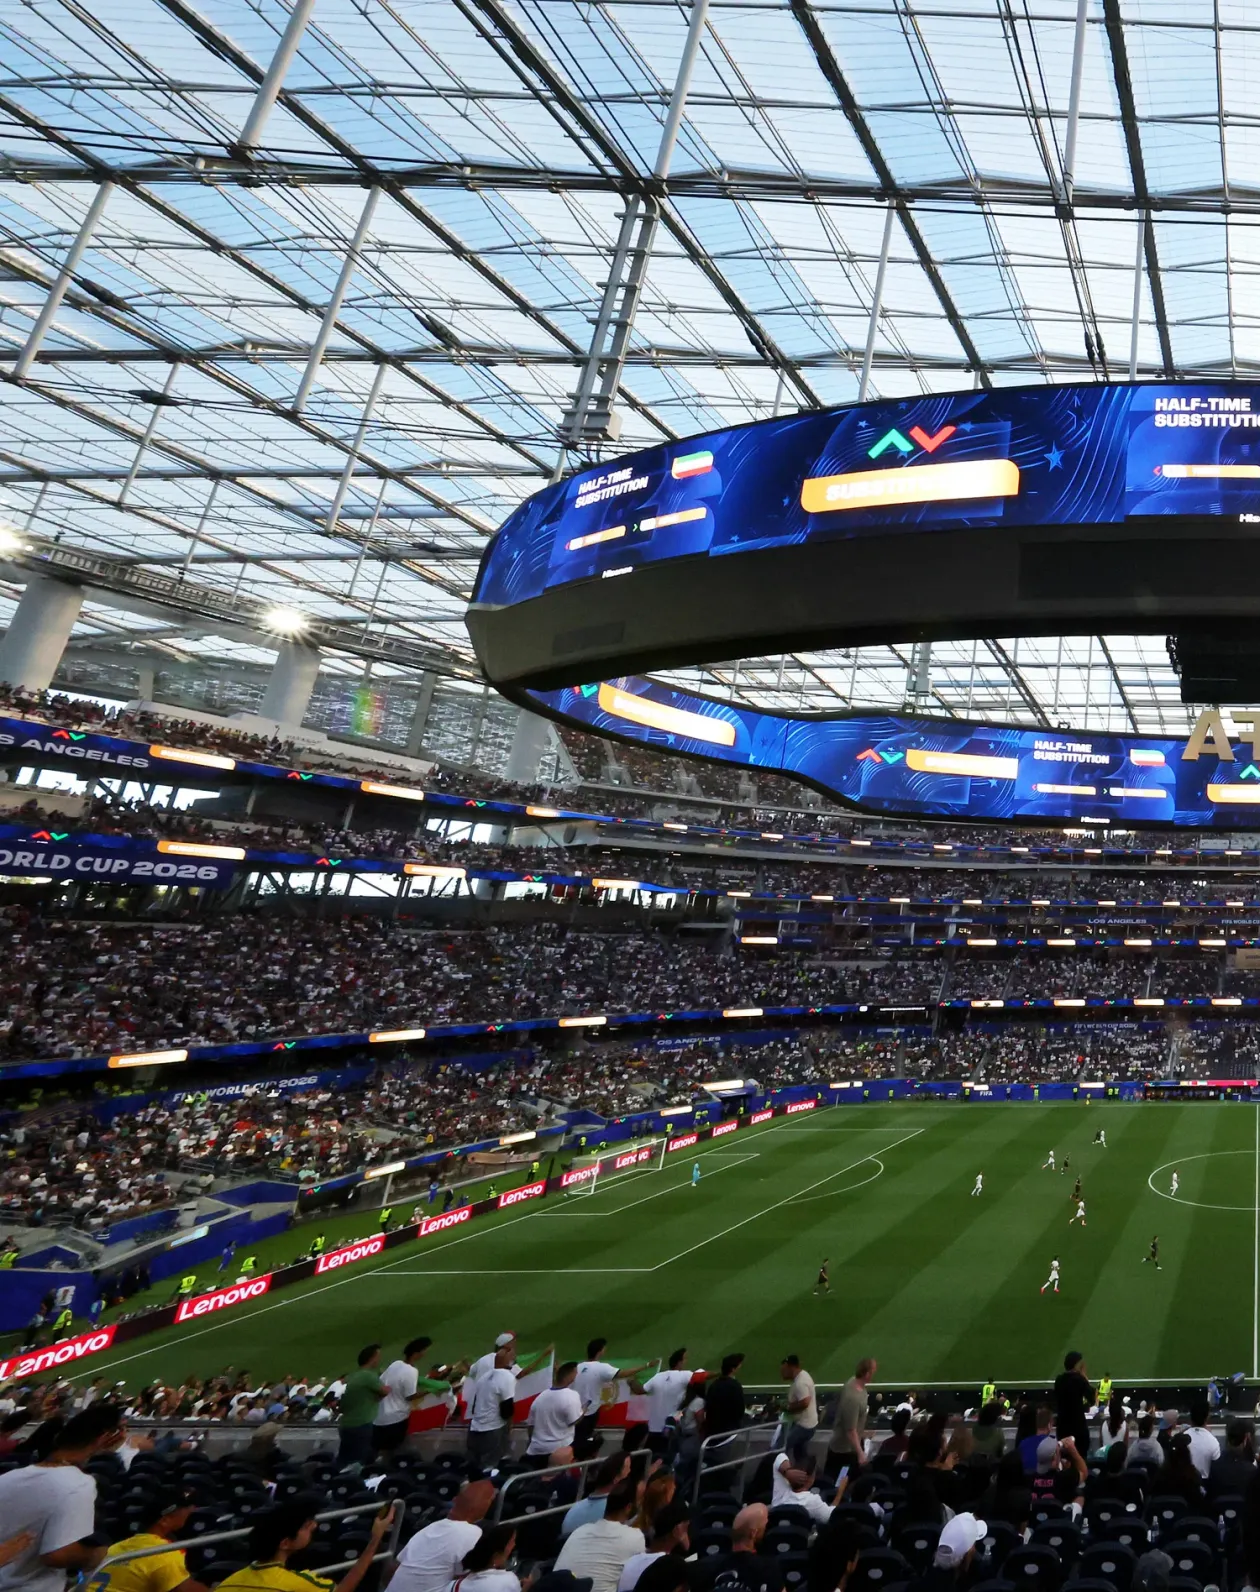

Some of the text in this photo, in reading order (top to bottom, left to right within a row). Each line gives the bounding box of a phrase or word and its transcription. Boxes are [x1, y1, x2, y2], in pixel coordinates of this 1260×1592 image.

[1155, 397, 1251, 412] HALF-TIME
[578, 467, 633, 495] HALF-TIME
[575, 476, 649, 508] SUBSTITUTION
[20, 739, 150, 768] ANGELES
[1034, 740, 1092, 753] HALF-TIME
[1033, 751, 1109, 764] SUBSTITUTION
[75, 857, 130, 874] CUP
[131, 862, 219, 880] 2026
[278, 1075, 318, 1088] 2026
[787, 1101, 815, 1114] Lenovo
[751, 1110, 773, 1125] Lenovo
[712, 1122, 737, 1137] Lenovo
[669, 1136, 697, 1151] Lenovo
[420, 1209, 470, 1236] Lenovo
[318, 1240, 381, 1272] Lenovo
[178, 1280, 266, 1321] Lenovo
